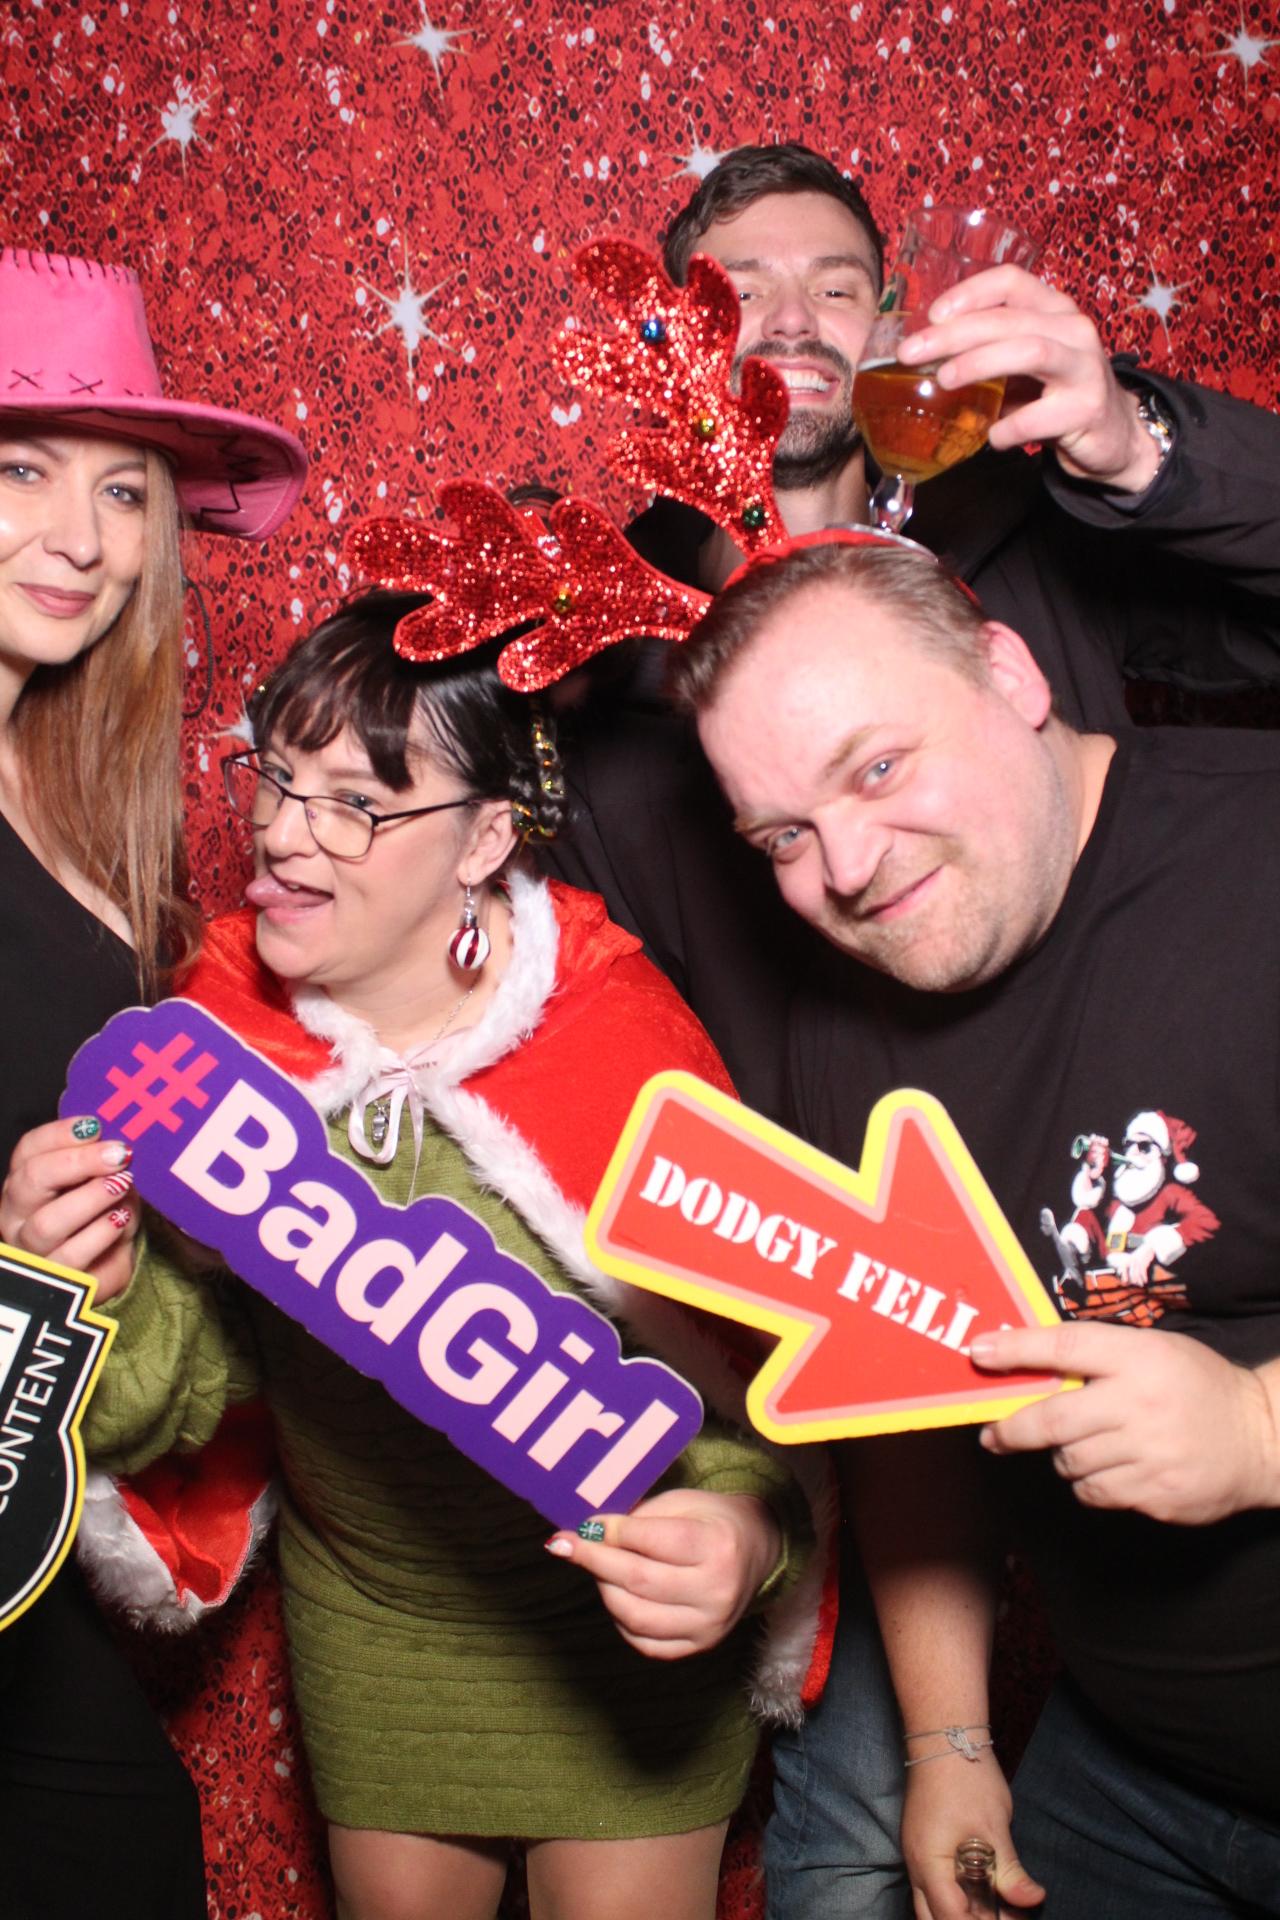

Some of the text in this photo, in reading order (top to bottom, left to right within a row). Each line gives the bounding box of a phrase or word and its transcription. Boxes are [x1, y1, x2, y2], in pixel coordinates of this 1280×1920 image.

[96, 1031, 680, 1509] #BadGirl
[638, 1155, 1013, 1357] DODGY FELL
